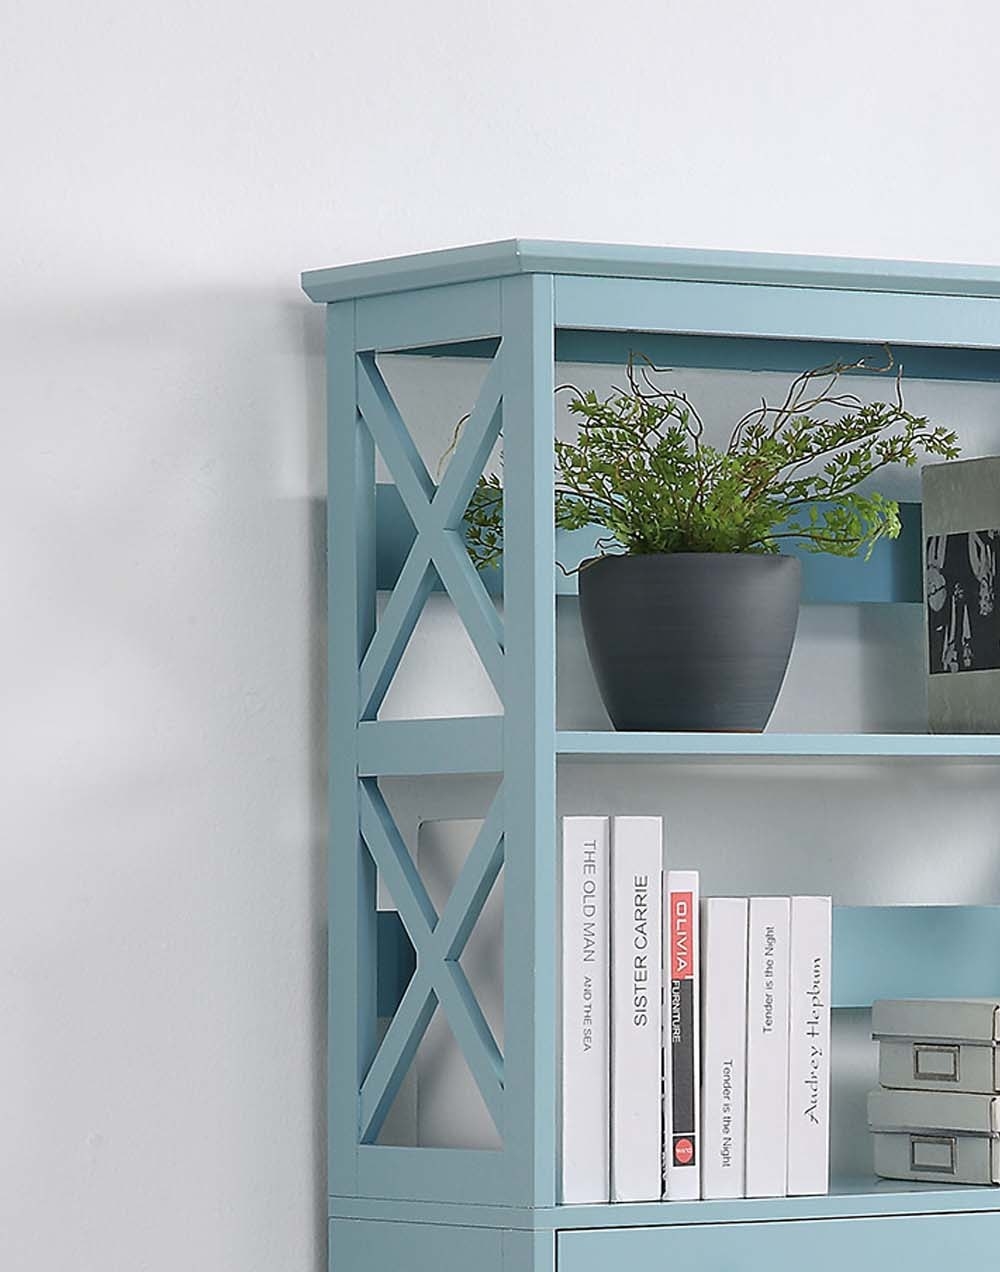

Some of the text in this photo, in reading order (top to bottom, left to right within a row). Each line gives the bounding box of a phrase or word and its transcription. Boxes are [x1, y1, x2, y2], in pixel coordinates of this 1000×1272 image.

[582, 839, 597, 1052] THE OLD MAN AND THE SEA
[633, 875, 649, 1027] SISTER CARRIE
[675, 901, 688, 972] OLIVIA
[763, 926, 776, 1034] Tender is the Night
[671, 979, 681, 1043] FURNITURE
[720, 1059, 733, 1168] Tender is the Night
[804, 1045, 823, 1125] Audrey
